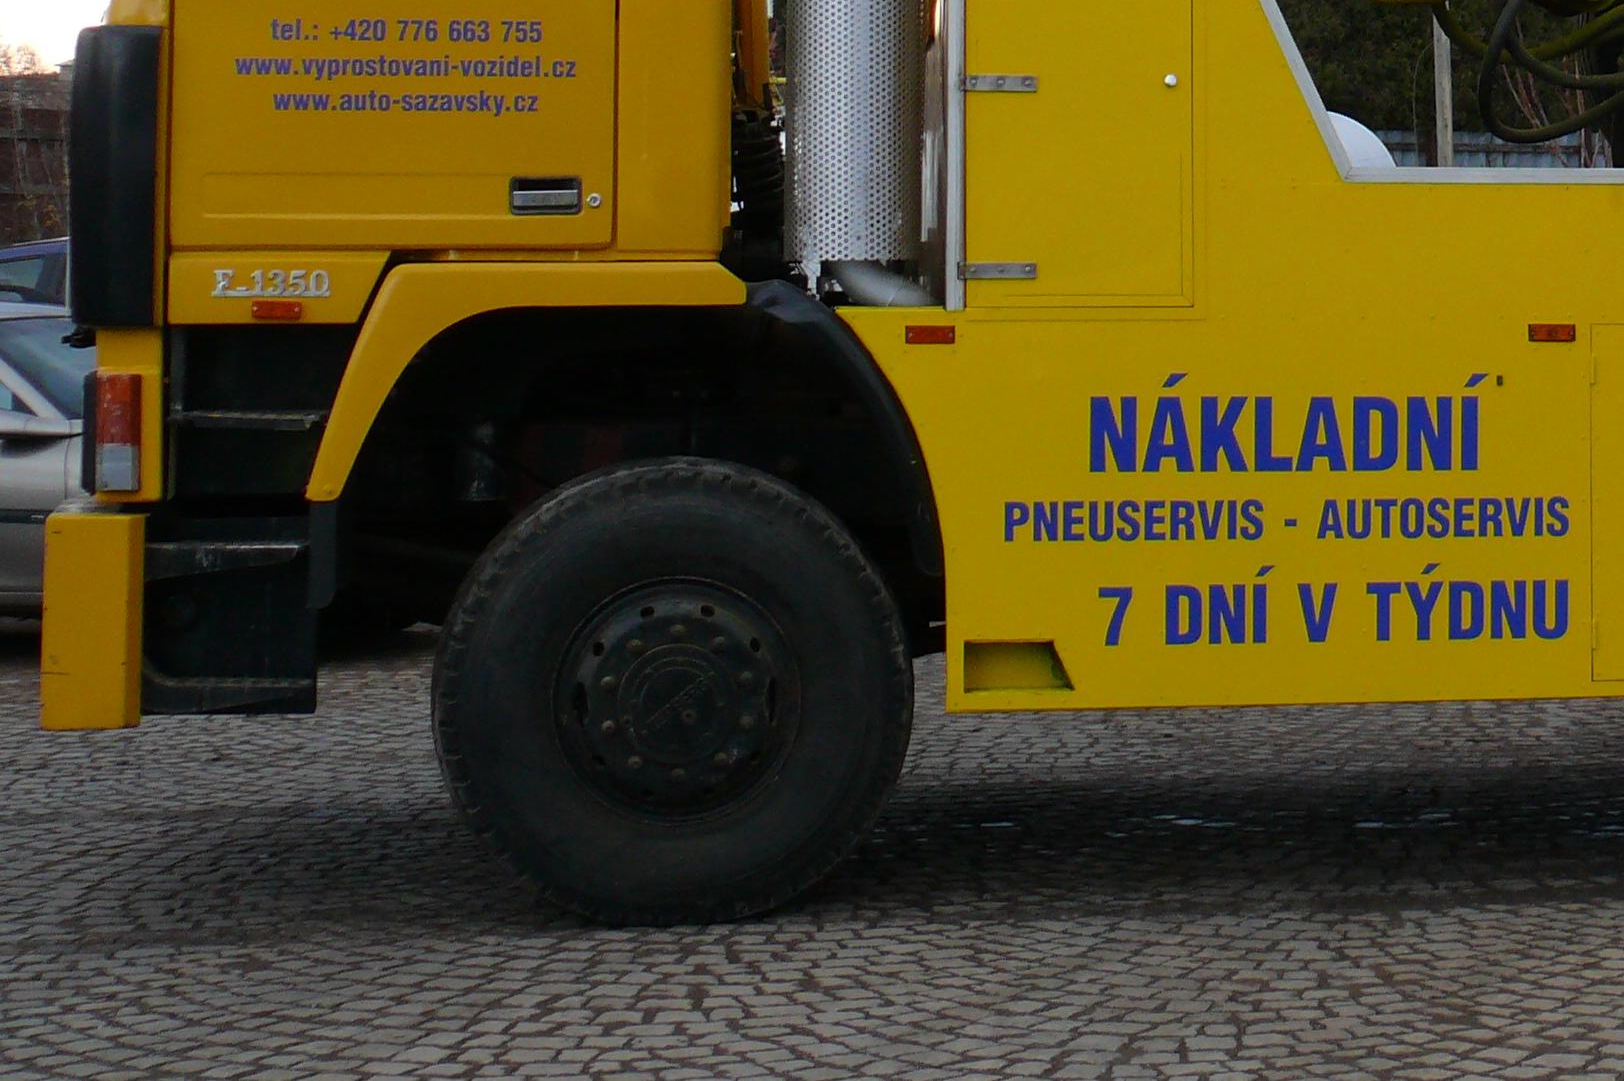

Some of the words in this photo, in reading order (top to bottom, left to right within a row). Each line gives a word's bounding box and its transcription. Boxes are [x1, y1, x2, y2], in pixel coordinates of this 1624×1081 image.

[271, 18, 319, 42] tel.:
[329, 18, 386, 42] +420
[397, 20, 438, 42] 776
[449, 20, 490, 43] 663
[501, 21, 543, 43] 755
[235, 54, 577, 81] www.vyprostovani-vozidel.cz
[272, 90, 539, 117] www.auto-sazavsky.cz
[1090, 373, 1488, 472] NÁKLADNÍ
[1005, 500, 1264, 541] PNEUSERVIS
[1319, 497, 1569, 538] AUTOSERVIS
[1098, 586, 1133, 646] 7
[1166, 566, 1272, 645] DNÍ
[1297, 583, 1337, 642] V
[1368, 564, 1569, 641] TÝDNU
